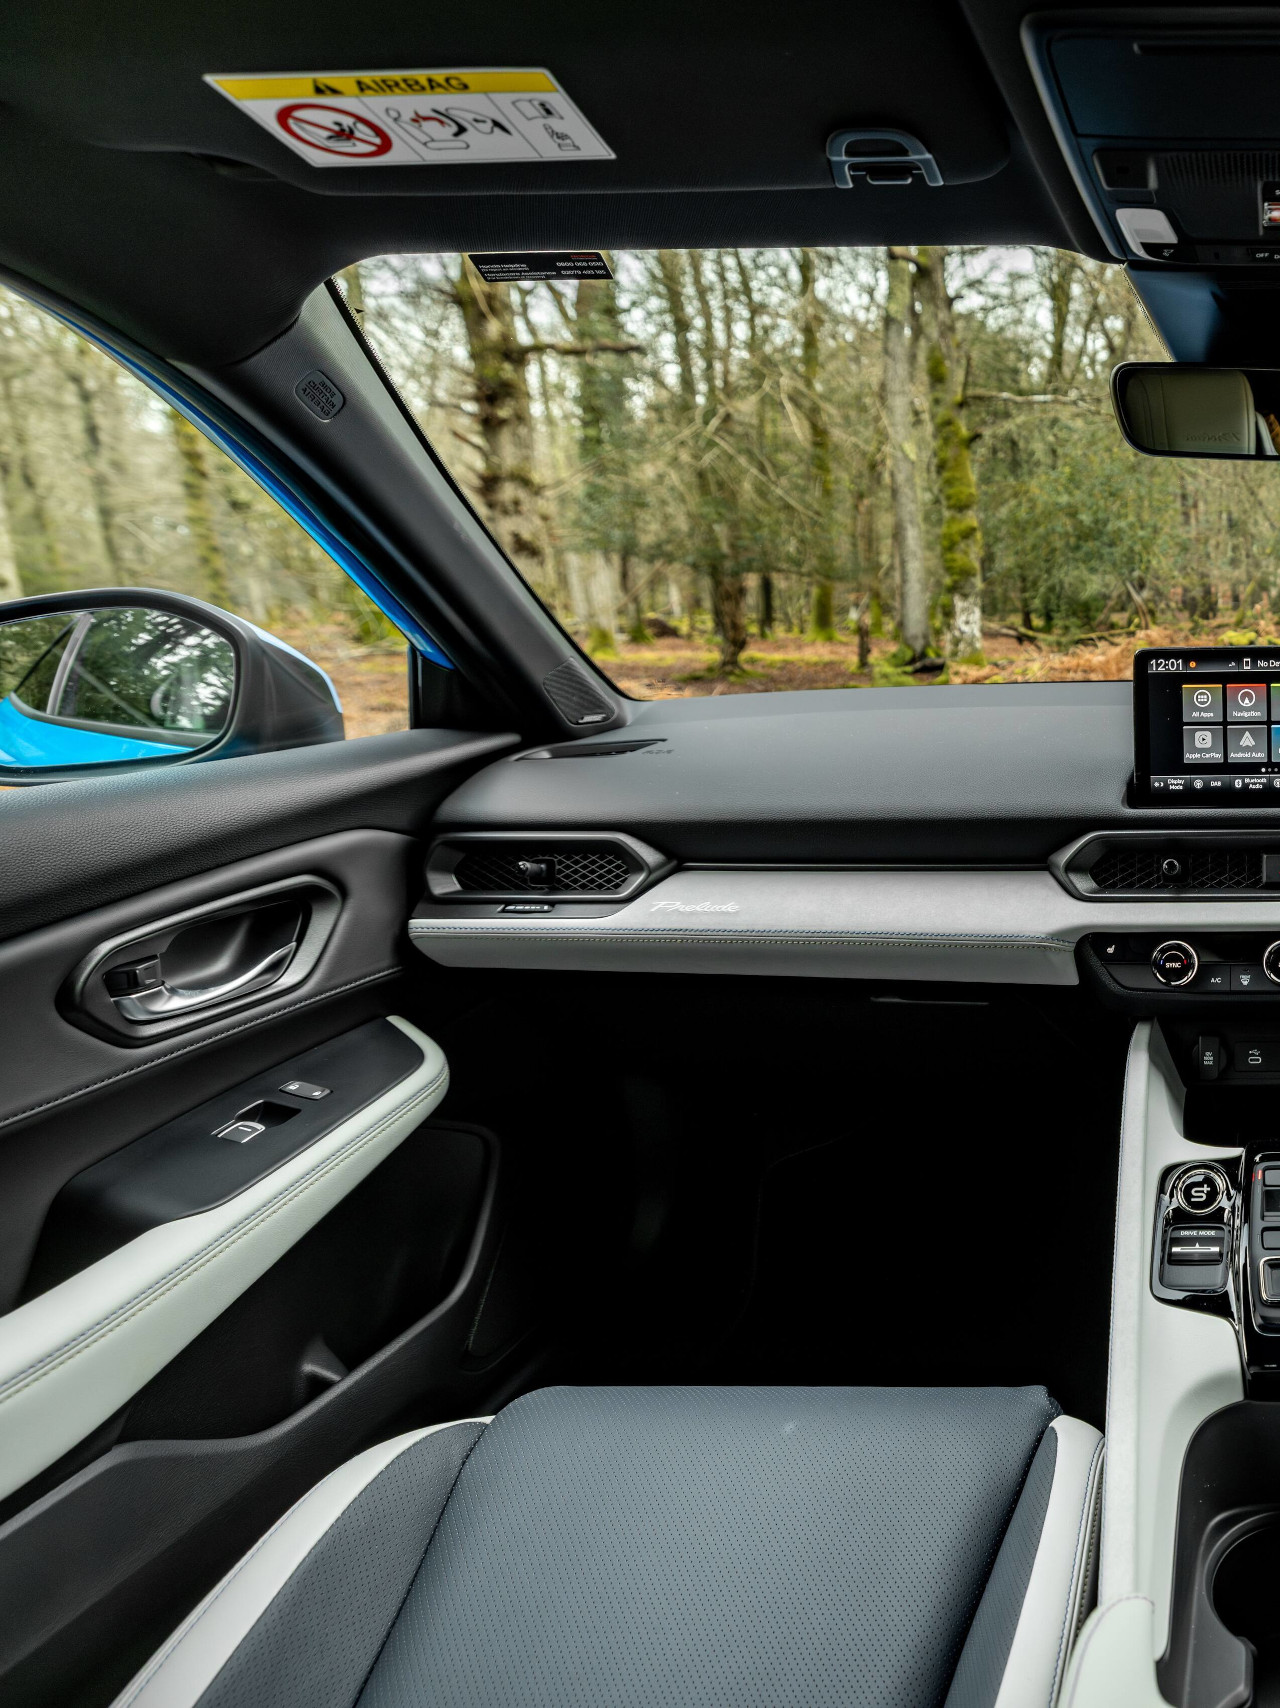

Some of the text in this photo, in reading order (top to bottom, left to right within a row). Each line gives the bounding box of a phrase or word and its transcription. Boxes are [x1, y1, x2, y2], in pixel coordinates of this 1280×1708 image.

[355, 76, 470, 94] AIRBAG
[308, 380, 337, 410] CURTAIN
[319, 380, 337, 399] SIDE
[301, 387, 331, 417] AIRBAG
[1150, 659, 1183, 671] 12:01
[1200, 711, 1214, 719] Apps
[1232, 710, 1262, 718] Navigation
[650, 901, 740, 913] Prelude
